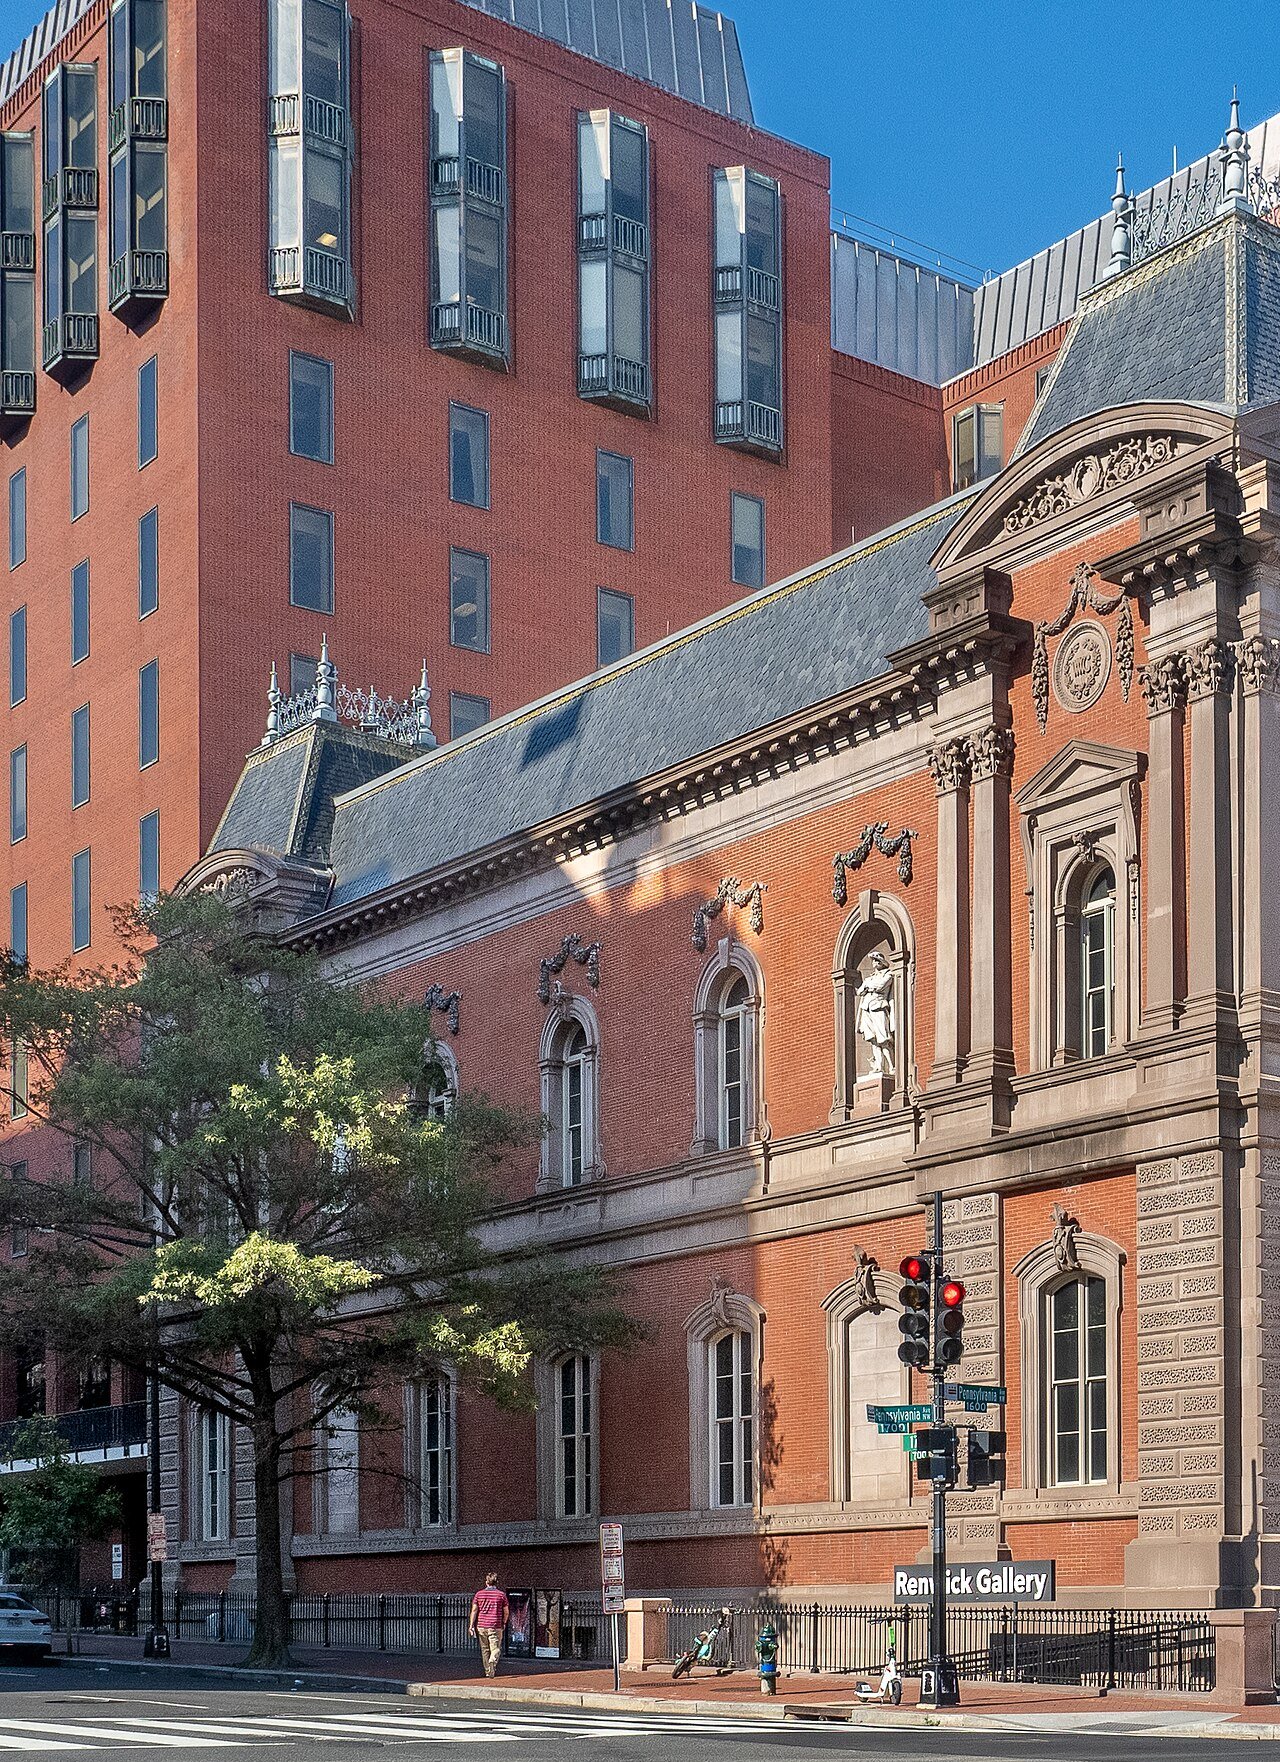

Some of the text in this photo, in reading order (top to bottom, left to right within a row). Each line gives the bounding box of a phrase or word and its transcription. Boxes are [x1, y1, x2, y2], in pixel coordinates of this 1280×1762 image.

[959, 1385, 997, 1402] Pennsylvania
[874, 1407, 921, 1423] Pennsylvania
[966, 1402, 986, 1412] 1600
[880, 1423, 906, 1433] 1700
[976, 1566, 1049, 1600] Gallery
